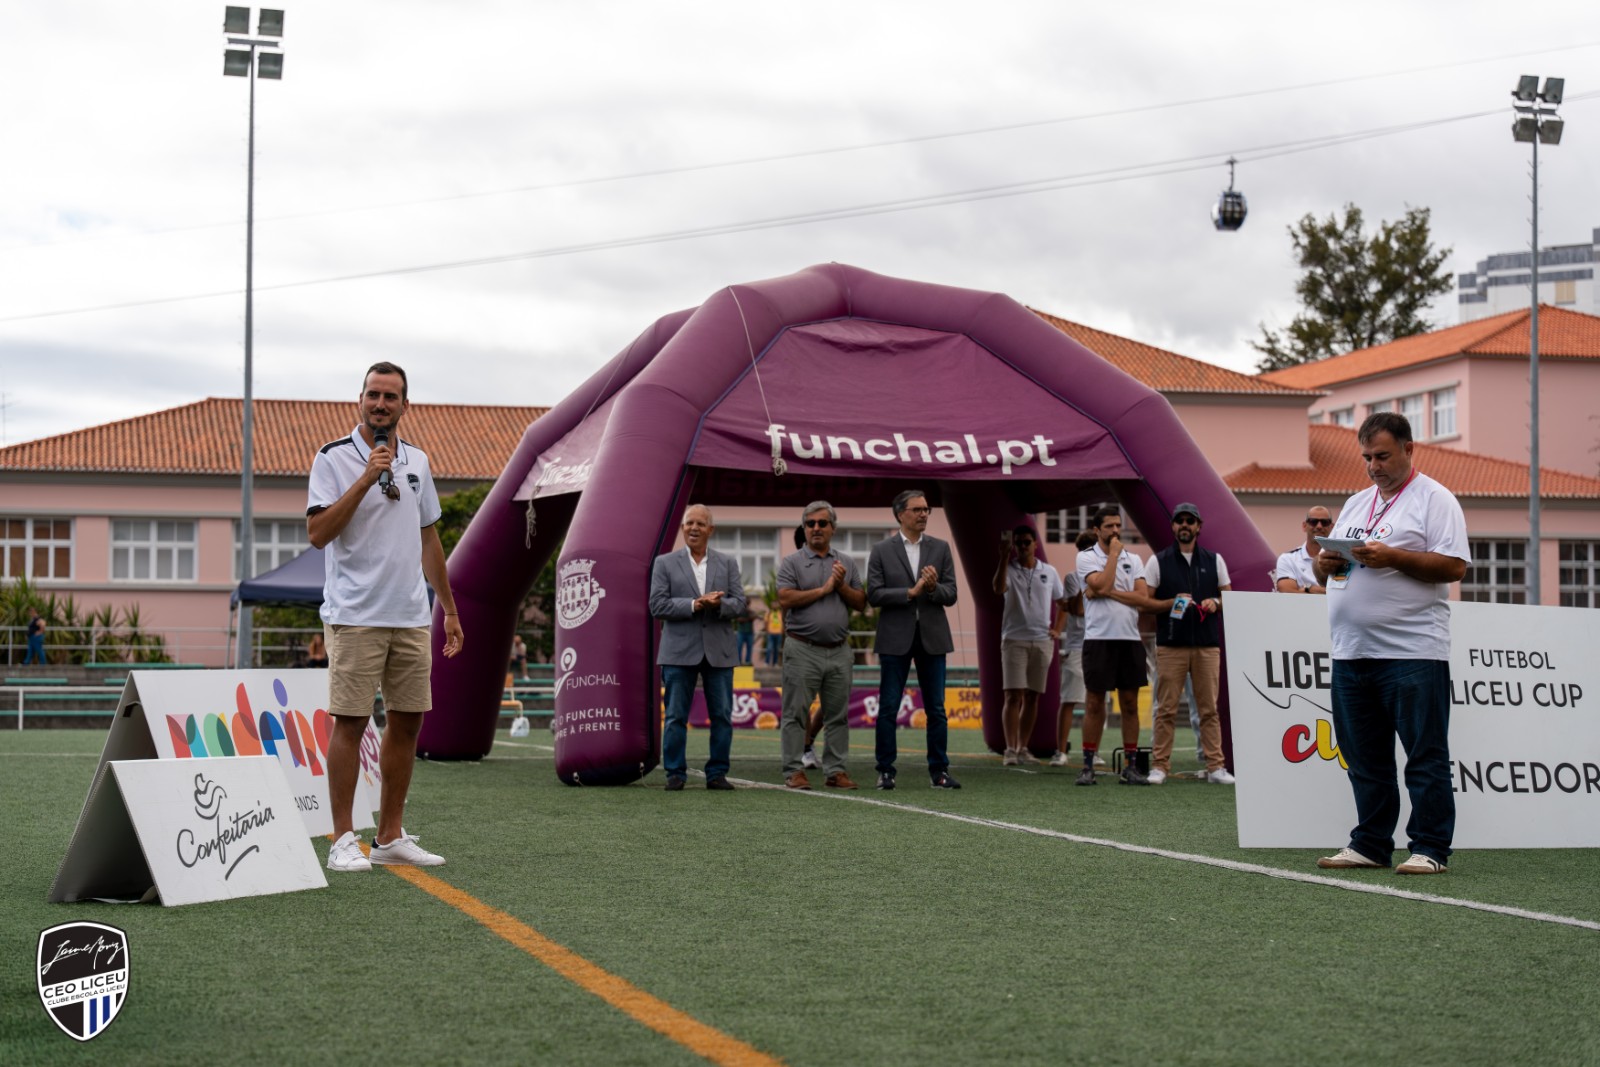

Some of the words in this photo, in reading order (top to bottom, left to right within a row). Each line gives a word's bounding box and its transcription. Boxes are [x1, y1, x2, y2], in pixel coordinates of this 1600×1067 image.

[765, 424, 1057, 474] funchal.pt
[1265, 651, 1332, 689] LICE
[1469, 649, 1556, 670] FUTEBOL
[566, 674, 621, 690] FUNCHAL
[1450, 679, 1523, 706] LICEU
[1533, 682, 1583, 708] CUP
[566, 708, 621, 723] FUNCHAL
[579, 722, 621, 734] FRENTE
[1282, 719, 1349, 770] cu
[177, 800, 275, 868] Confeitaria
